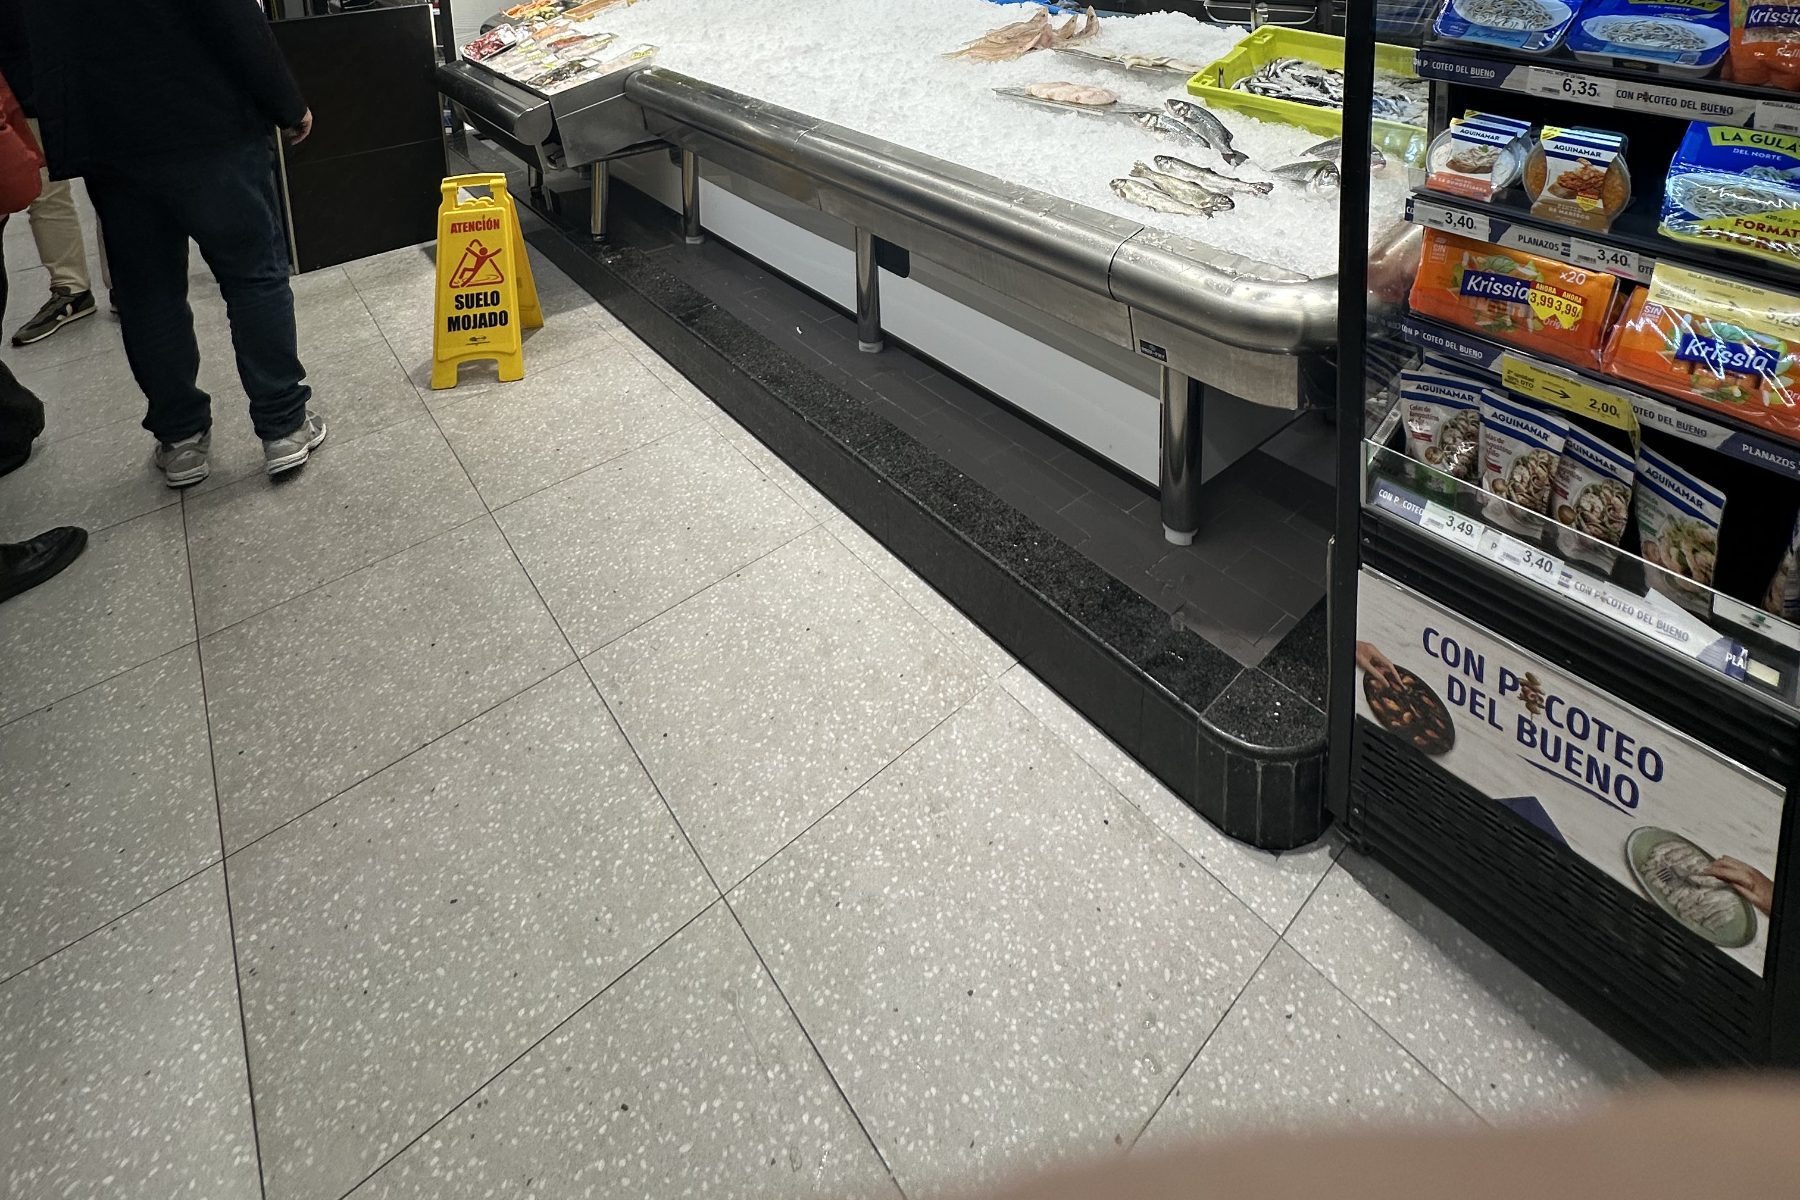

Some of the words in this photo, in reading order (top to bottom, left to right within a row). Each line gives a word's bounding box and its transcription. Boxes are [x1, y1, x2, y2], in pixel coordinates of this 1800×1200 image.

[1422, 59, 1454, 72] PCOTEO
[1455, 65, 1469, 75] DEL
[1470, 66, 1496, 79] BUENO
[1616, 89, 1634, 100] CON
[1680, 99, 1698, 111] DEL
[1700, 102, 1734, 116] BUENO
[1459, 128, 1501, 141] AGUINAMAR
[1720, 131, 1744, 142] LA
[1750, 133, 1798, 153] GULA
[1553, 144, 1602, 158] AGUINAMAR
[1732, 147, 1750, 156] DEL
[1751, 151, 1782, 161] NORTE
[450, 215, 501, 234] ATENCIÓN
[1734, 218, 1800, 239] FORMAT
[1517, 233, 1560, 252] PLANAZOS
[1466, 273, 1530, 301] Krissia
[1535, 282, 1557, 295] AHORA
[1562, 291, 1583, 304] AHORA
[454, 290, 501, 311] SUELO
[1644, 304, 1663, 315] SIN
[447, 309, 509, 333] MOJADO
[1414, 329, 1444, 346] PCOTEO
[1445, 339, 1458, 351] DEL
[1459, 344, 1483, 359] BUENO
[1684, 338, 1769, 371] Krissia
[1415, 383, 1475, 403] AGUINAMAR
[1490, 411, 1549, 442] AGUINAMAR
[1657, 414, 1674, 426] DEL
[1676, 420, 1708, 438] BUENO
[1564, 439, 1617, 474] GUINAMAR
[1742, 443, 1796, 470] PLANAZOS
[1645, 467, 1704, 510] AGUINAMAR
[1378, 488, 1394, 501] CON
[1394, 495, 1424, 516] PCOTEO
[1574, 580, 1593, 598] CON
[1637, 609, 1654, 626] DEL
[1656, 619, 1690, 643] BUENO
[1422, 627, 1485, 684] CON
[1447, 673, 1504, 732] DEL
[1516, 713, 1641, 810] BUENO
